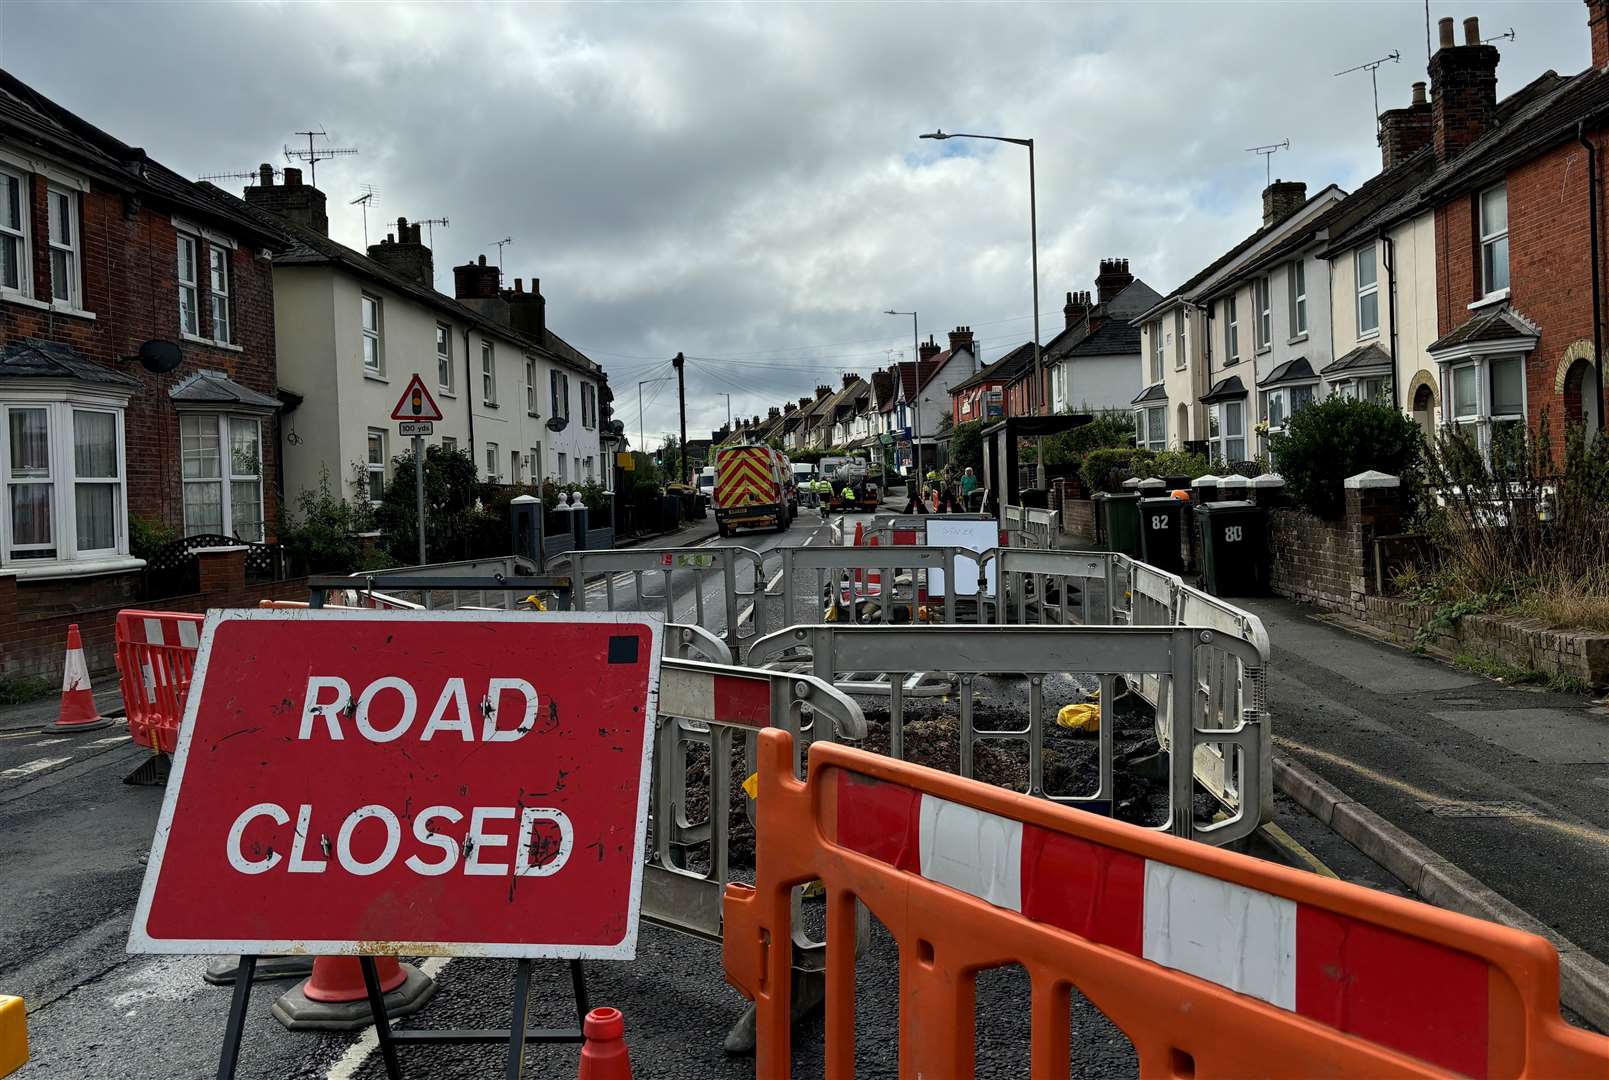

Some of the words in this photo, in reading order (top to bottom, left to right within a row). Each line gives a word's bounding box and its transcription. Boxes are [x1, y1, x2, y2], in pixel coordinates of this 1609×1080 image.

[1152, 515, 1168, 529] 82
[1225, 526, 1242, 542] 80
[298, 676, 539, 743] ROAD
[226, 803, 574, 877] CLOSED
